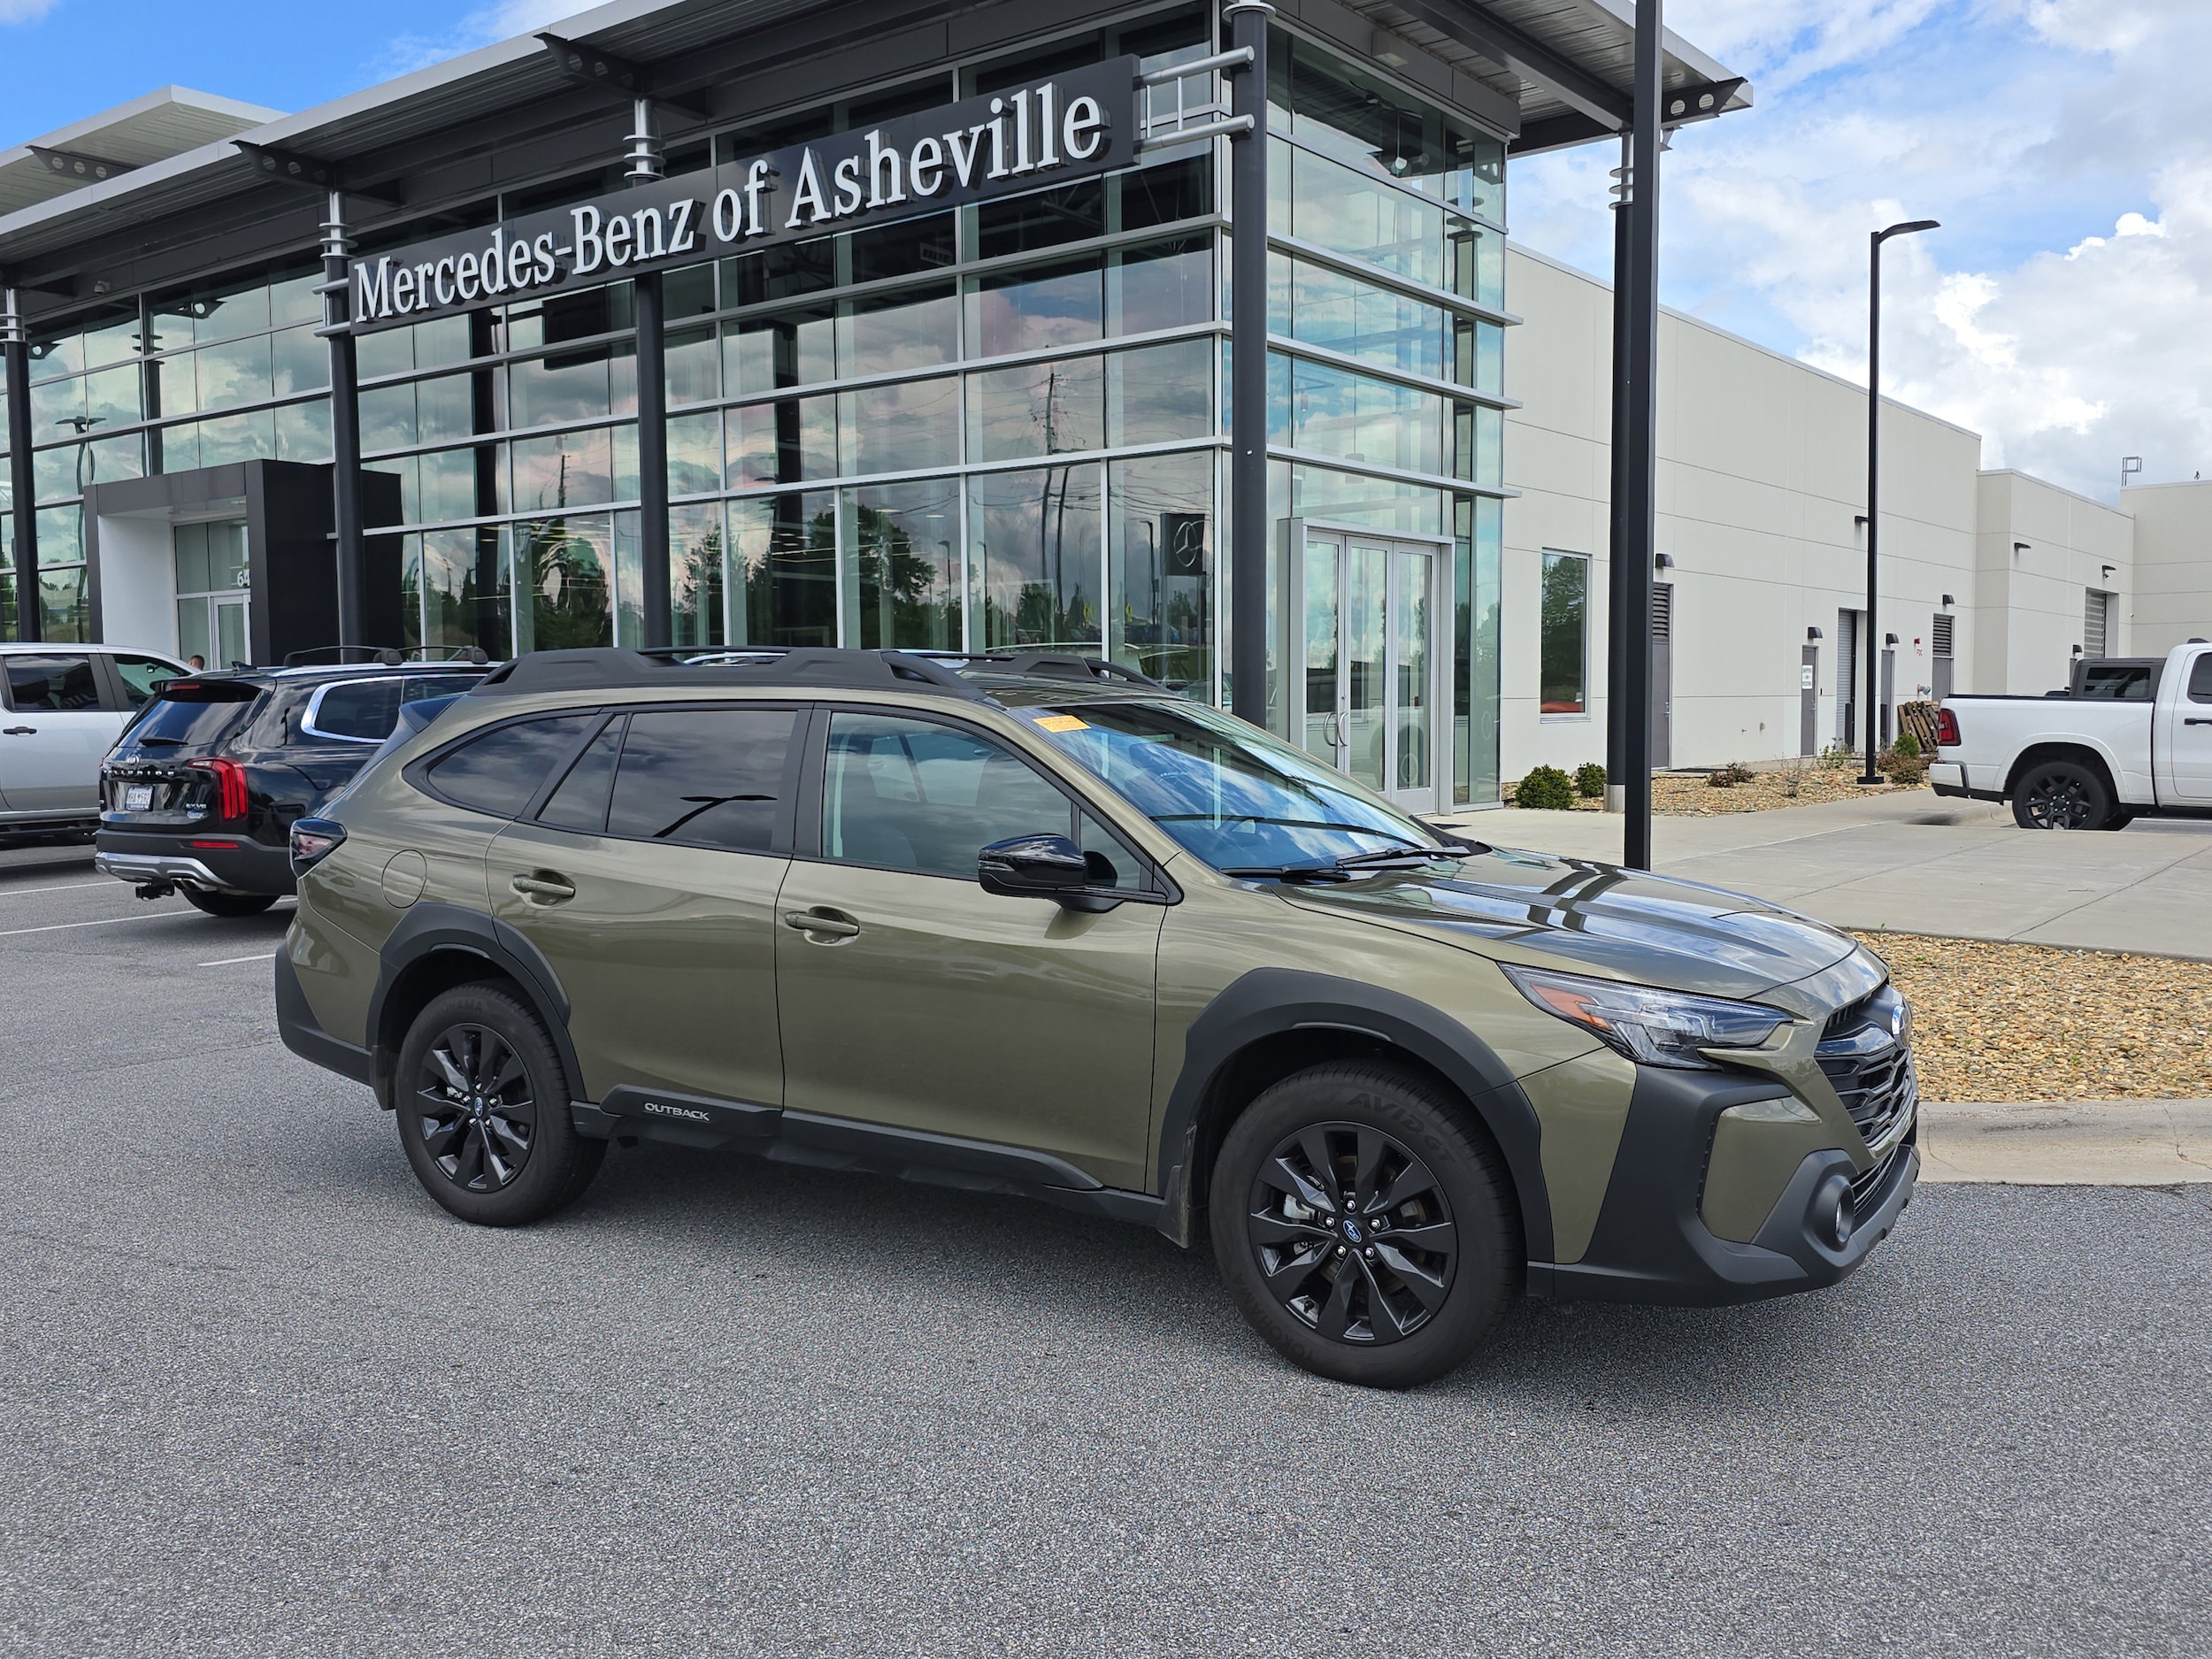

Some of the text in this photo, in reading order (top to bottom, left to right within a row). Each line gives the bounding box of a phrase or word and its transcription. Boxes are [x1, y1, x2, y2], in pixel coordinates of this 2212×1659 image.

[354, 81, 1102, 323] Mercedes-Benz of Asheville
[644, 1102, 710, 1122] OUTBACK
[1346, 1092, 1425, 1133] AVID
